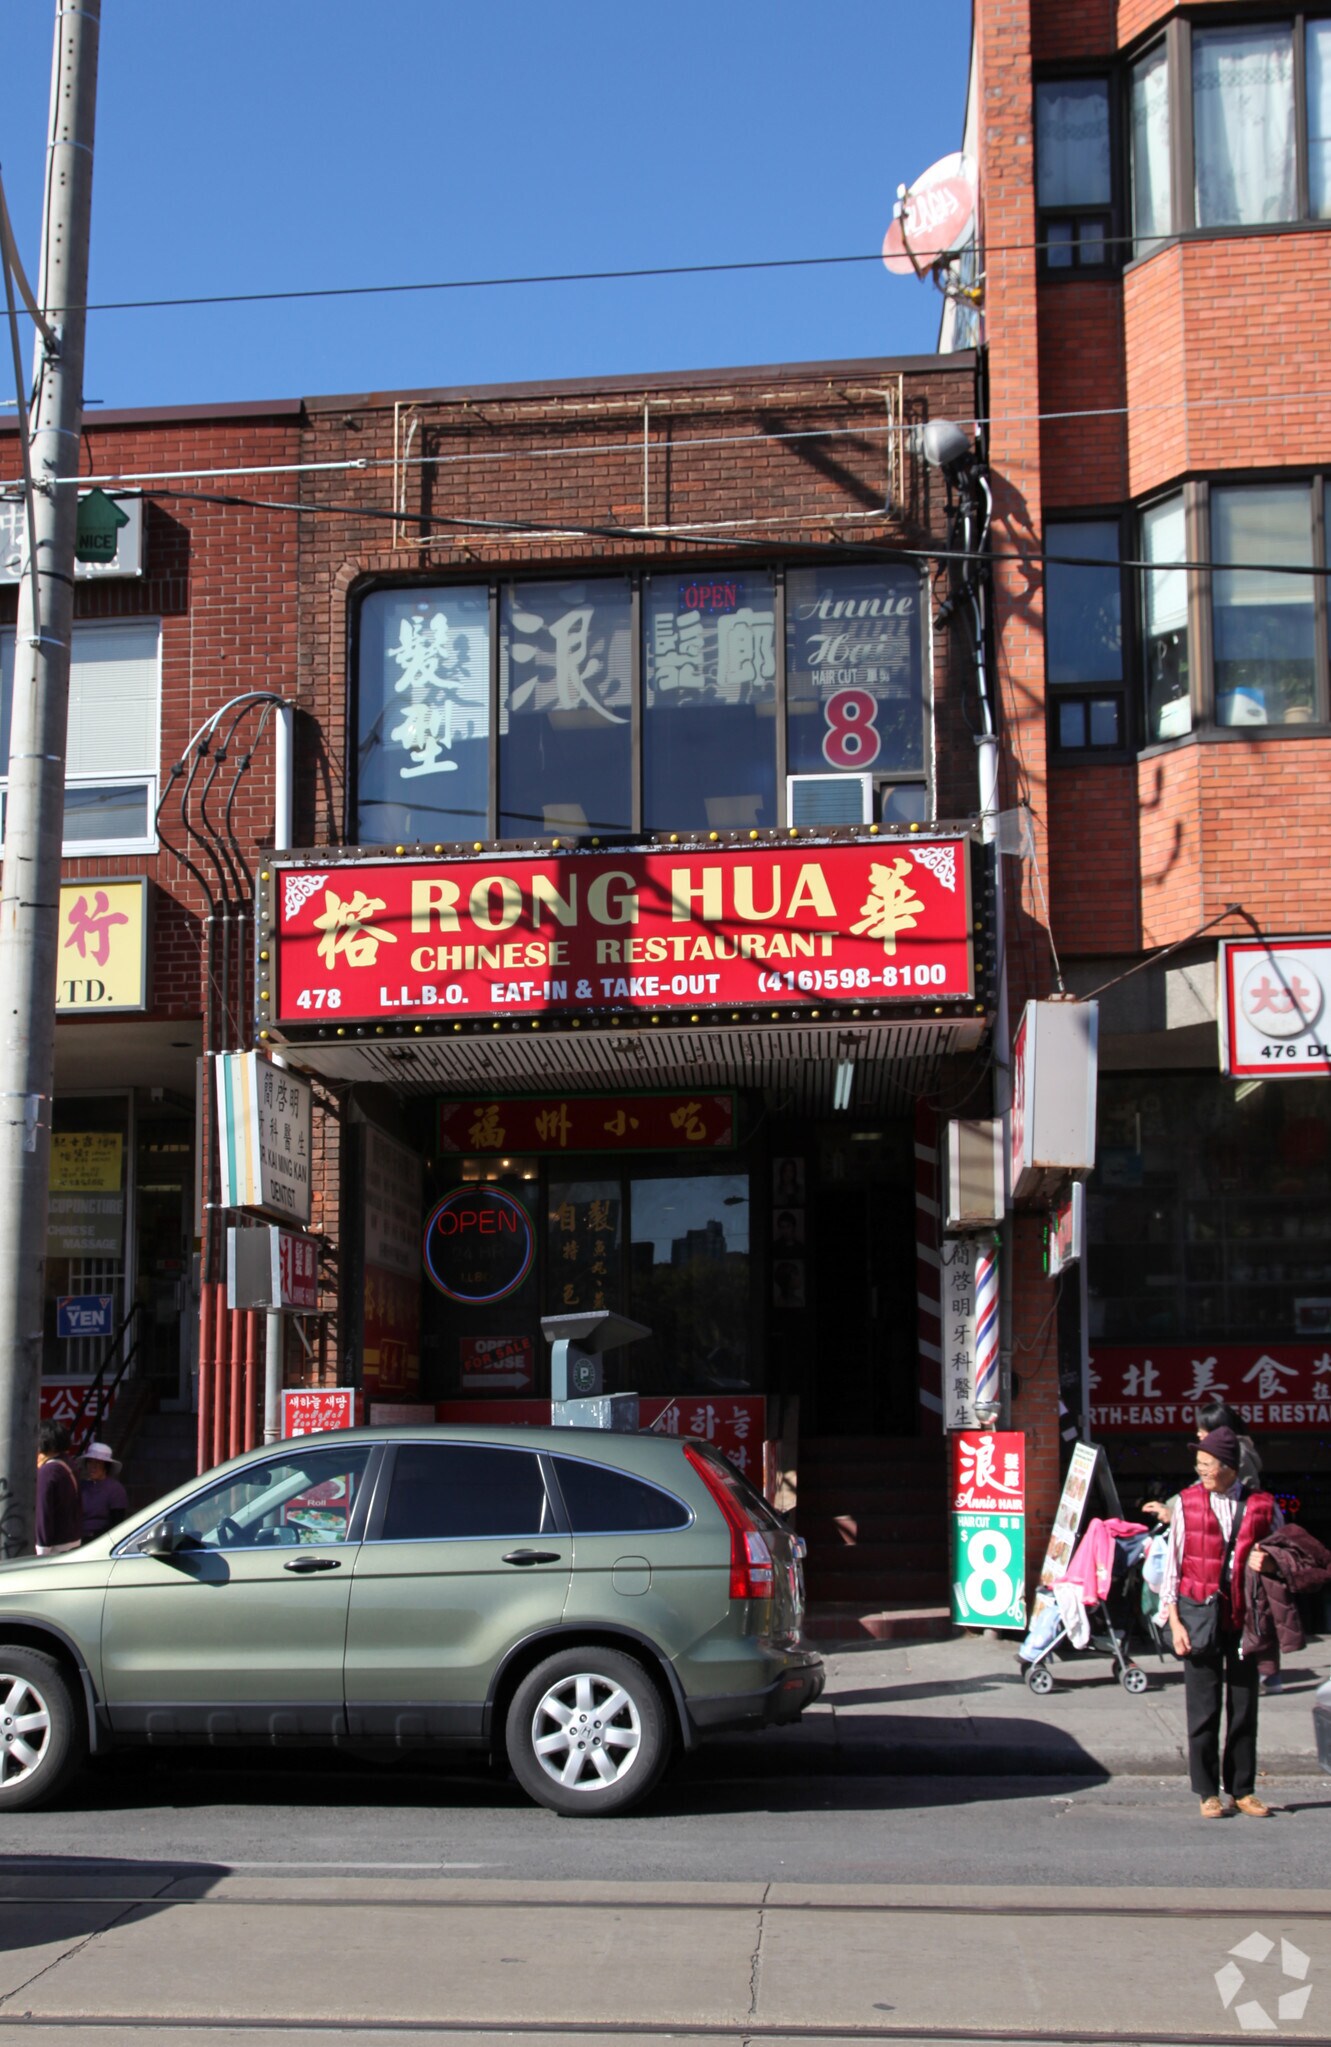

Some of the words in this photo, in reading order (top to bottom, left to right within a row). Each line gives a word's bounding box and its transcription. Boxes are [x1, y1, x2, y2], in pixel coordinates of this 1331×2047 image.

[79, 534, 113, 549] NICE
[685, 585, 736, 608] OPEN
[796, 589, 915, 620] Annie
[511, 606, 630, 723] 浪
[812, 669, 835, 685] HAIR
[838, 668, 857, 684] CUT
[387, 612, 462, 778] 髮型
[823, 687, 881, 770] 8
[411, 871, 639, 933] RONG
[671, 863, 837, 923] HUA
[849, 857, 925, 955] 華
[313, 889, 398, 970] 榕
[410, 941, 570, 972] CHINESE
[596, 931, 839, 964] RESTAURANT
[56, 979, 113, 1003] TD.
[380, 985, 468, 1007] L.L.B.O.
[490, 980, 566, 1002] EAT-IN
[575, 979, 592, 999] &
[600, 974, 720, 998] TAKE-OUT
[758, 964, 946, 993] (416)598-8100
[297, 989, 342, 1009] 478
[1261, 1045, 1296, 1058] 476
[468, 1102, 706, 1149] 福州小吃
[268, 1149, 277, 1170] KAI
[278, 1154, 292, 1178] MING
[294, 1161, 307, 1183] KAN
[270, 1179, 296, 1208] DENTIST
[437, 1209, 518, 1235] OPEN
[63, 1239, 117, 1250] MASSAGE
[67, 1310, 105, 1327] YEN
[464, 1352, 491, 1372] FOR
[496, 1337, 529, 1359] SALE
[475, 1340, 512, 1354] OPE
[40, 1389, 111, 1421] 公司
[289, 1395, 321, 1409] 새하늘
[1089, 1405, 1177, 1425] RTH-EAST
[1269, 1404, 1331, 1424] RESTA
[959, 1436, 1023, 1494] 浪
[307, 1499, 327, 1507] Roll
[954, 1487, 997, 1510] Annie
[998, 1498, 1023, 1511] HAIR
[957, 1515, 975, 1527] HAIR
[975, 1516, 990, 1528] CUT
